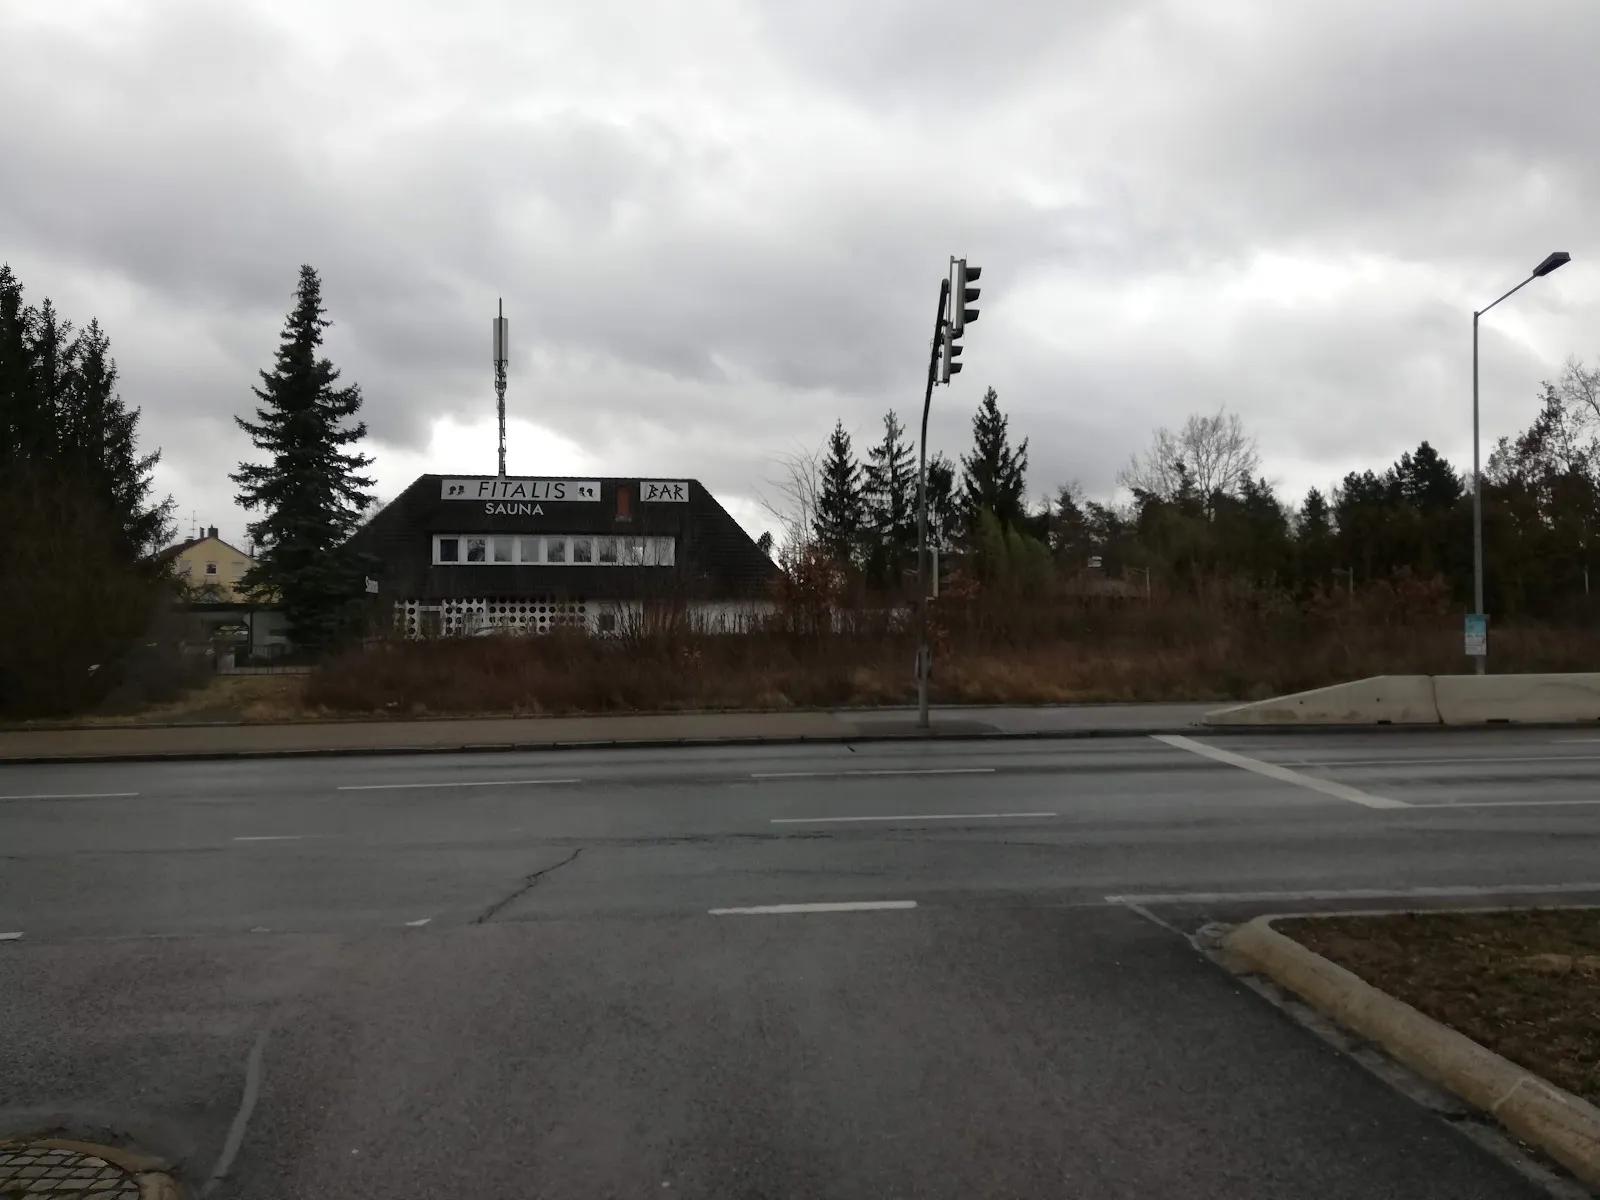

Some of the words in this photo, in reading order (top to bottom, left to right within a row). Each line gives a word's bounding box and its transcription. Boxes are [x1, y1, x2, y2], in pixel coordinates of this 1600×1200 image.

[478, 481, 565, 499] FITALIS
[647, 484, 683, 500] BAR
[484, 502, 544, 515] SAUNA
